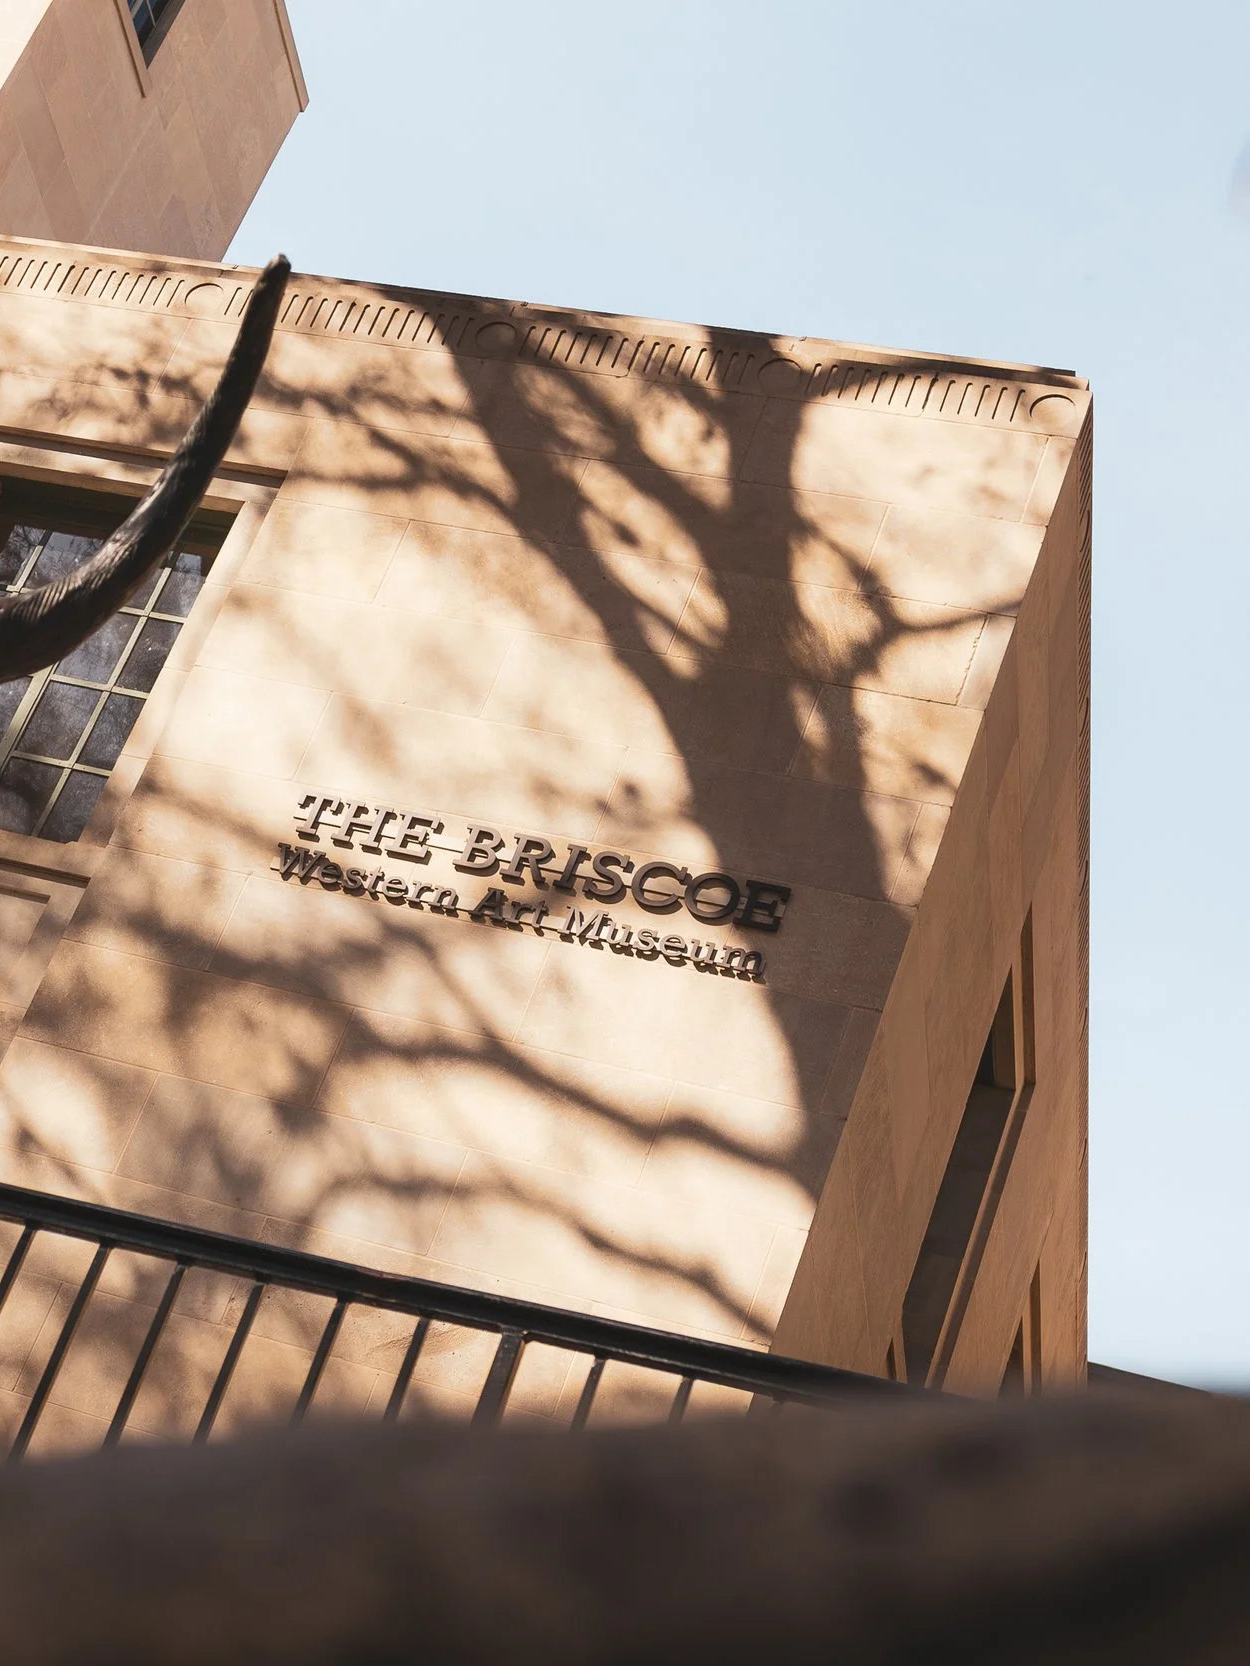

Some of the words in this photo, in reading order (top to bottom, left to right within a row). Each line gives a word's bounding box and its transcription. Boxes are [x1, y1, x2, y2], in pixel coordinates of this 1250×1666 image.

[277, 842, 458, 911] Western
[469, 887, 548, 929] Art
[557, 905, 766, 977] Museum
[296, 792, 441, 858] THE
[453, 823, 791, 932] BRISCOE
